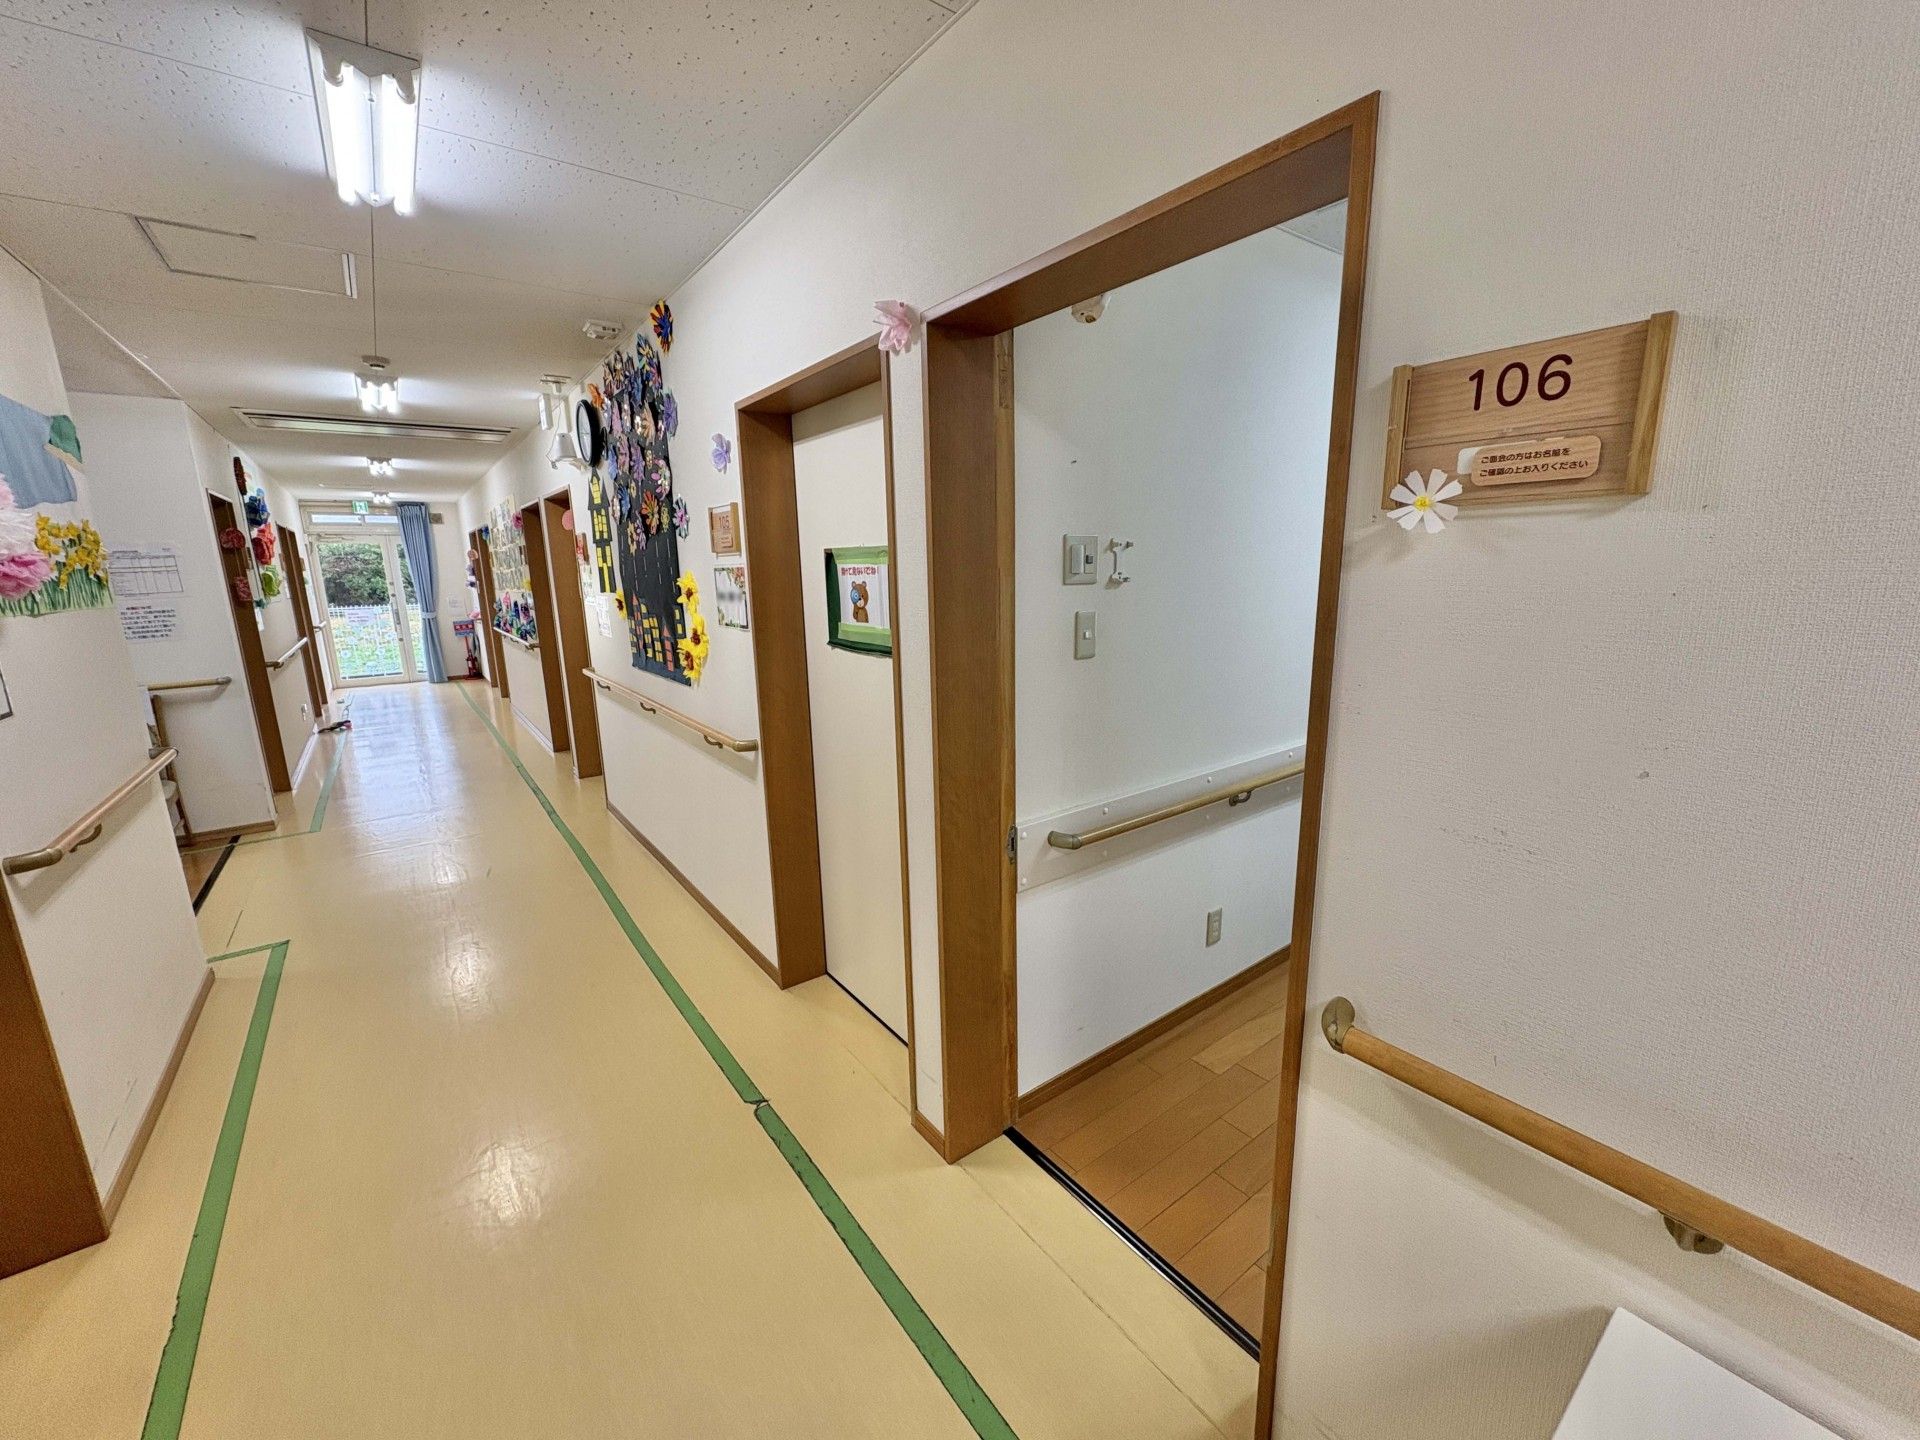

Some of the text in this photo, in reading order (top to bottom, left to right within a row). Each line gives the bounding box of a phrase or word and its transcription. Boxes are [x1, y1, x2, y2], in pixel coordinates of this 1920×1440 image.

[1468, 353, 1574, 412] 106
[1481, 447, 1571, 464] ご面会の方はお名前を
[1479, 460, 1589, 477] ご確認の上お入りください
[718, 514, 730, 529] 105
